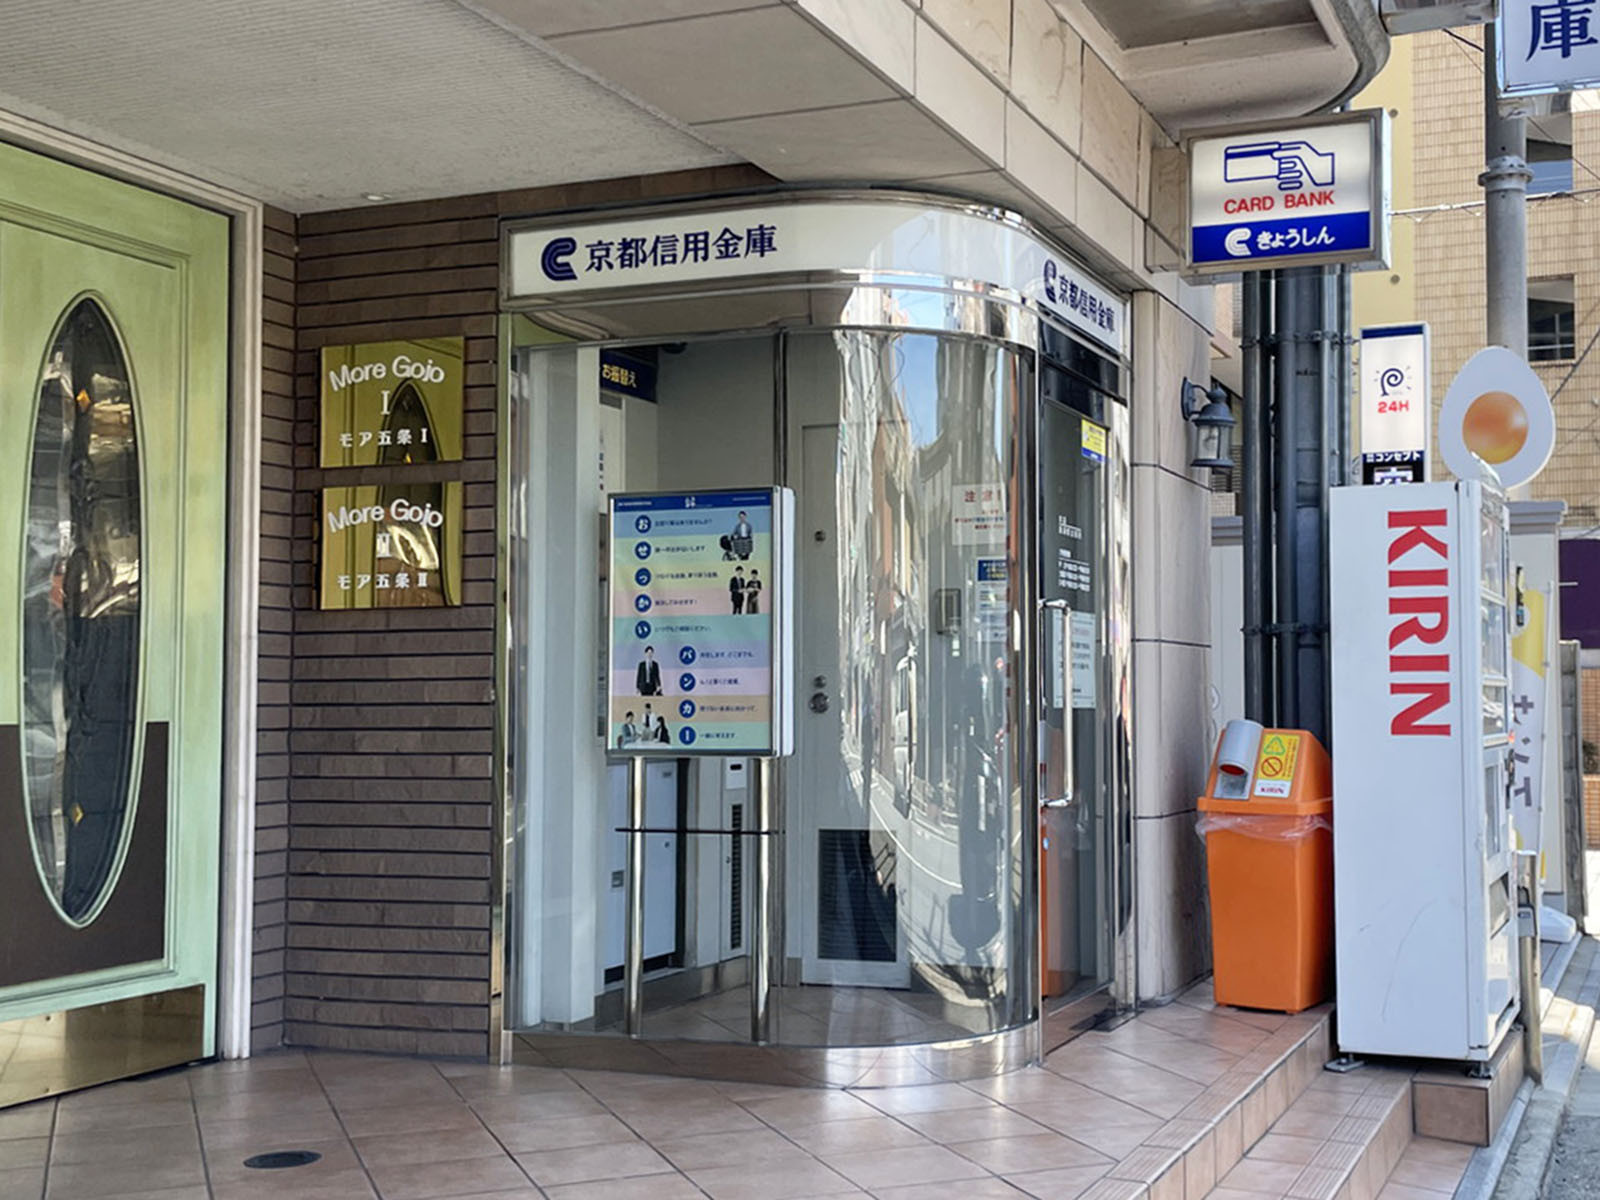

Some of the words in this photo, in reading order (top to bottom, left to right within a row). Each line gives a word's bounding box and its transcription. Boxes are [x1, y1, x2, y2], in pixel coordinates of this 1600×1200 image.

[1526, 0, 1598, 61] 庫
[1224, 195, 1275, 215] CARD
[1284, 189, 1335, 209] BANK
[584, 224, 777, 272] 京都信用金庫
[1256, 226, 1336, 251] きょうしん
[329, 364, 387, 392] More
[391, 354, 446, 384] Gojo
[1377, 399, 1410, 414] 24H
[327, 506, 386, 534] More
[389, 498, 444, 529] Gojo
[1387, 508, 1452, 736] KIRIN
